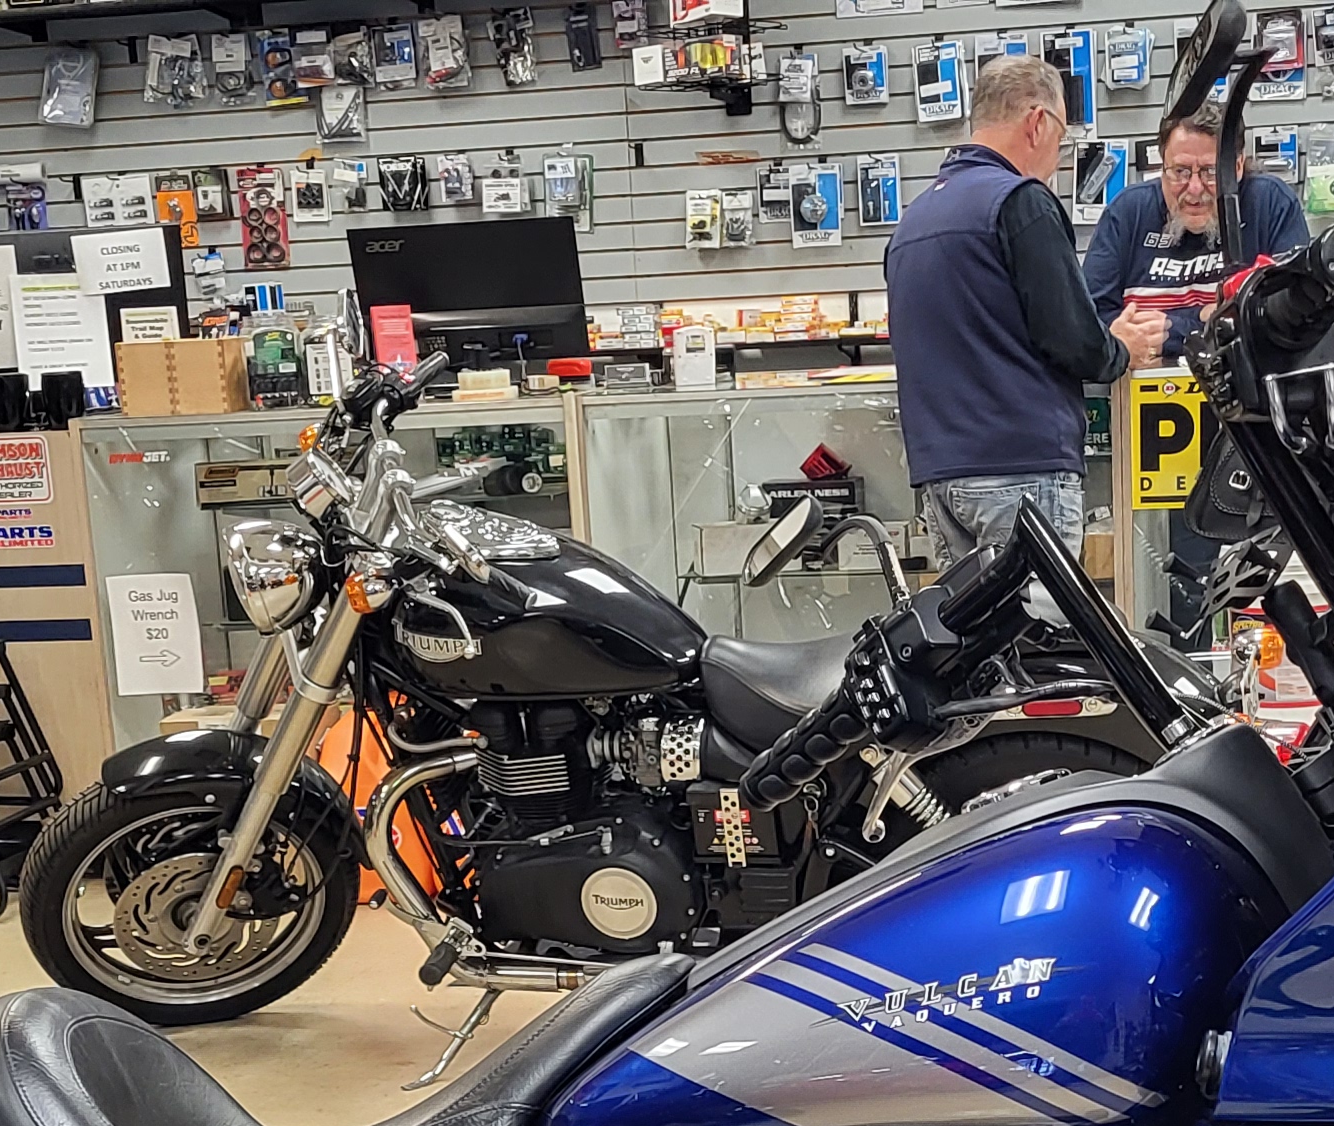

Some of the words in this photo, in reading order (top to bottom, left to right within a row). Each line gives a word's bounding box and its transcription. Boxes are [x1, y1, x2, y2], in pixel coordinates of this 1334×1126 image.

[926, 104, 954, 115] DRAG
[802, 231, 830, 242] DRAG
[100, 244, 141, 256] CLOSING
[366, 238, 406, 254] acer
[105, 263, 118, 272] AT
[119, 260, 142, 271] 1PM
[98, 277, 153, 290] SATURDAYS
[148, 325, 164, 334] Map
[814, 487, 850, 497] NESS
[128, 590, 153, 602] Gas
[156, 588, 179, 604] Jug
[131, 608, 179, 621] Wrench
[145, 627, 169, 641] $20
[391, 618, 482, 656] TRIUMPH
[592, 894, 645, 909] TRIUMPH
[836, 957, 1058, 1022] VULCAN
[861, 985, 1042, 1033] VAQUERO
